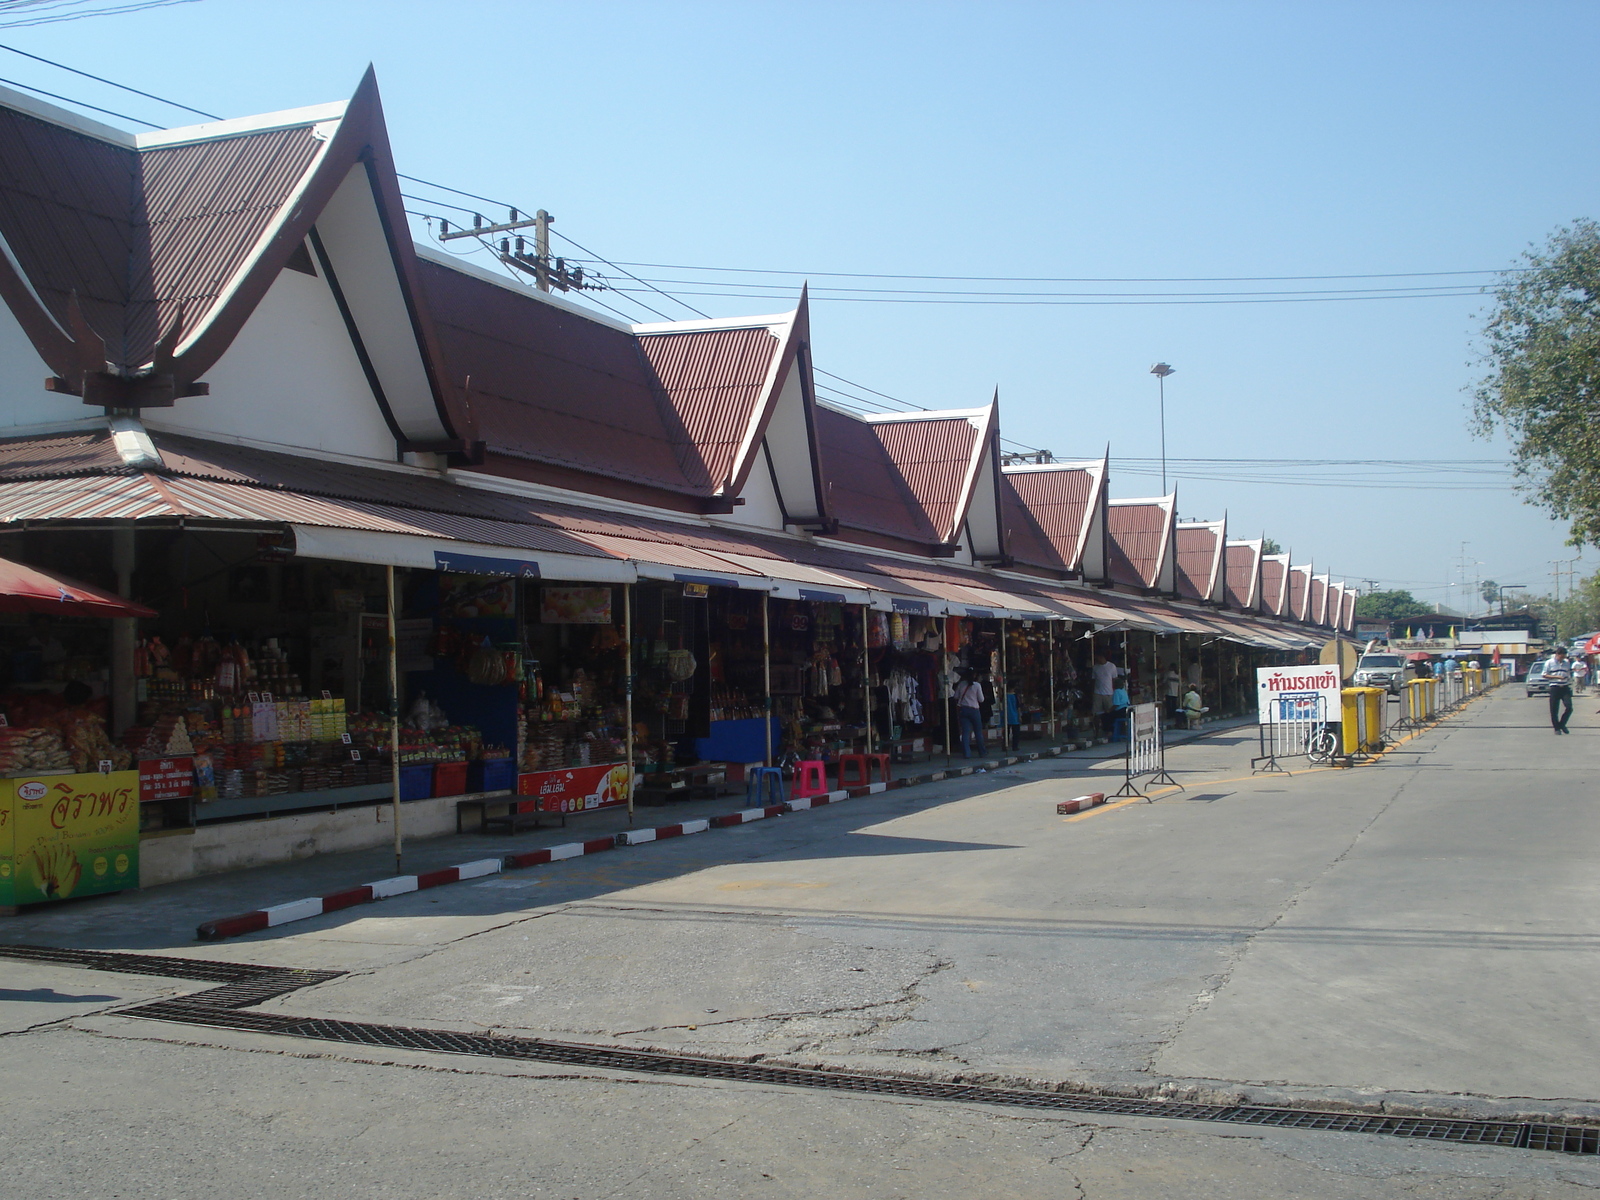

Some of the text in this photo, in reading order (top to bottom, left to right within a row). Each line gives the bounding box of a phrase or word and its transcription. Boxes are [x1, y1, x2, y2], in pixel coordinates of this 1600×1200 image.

[792, 616, 807, 629] 99
[1268, 670, 1337, 691] ห้ามรถเข้า
[50, 783, 133, 829] จิราพร
